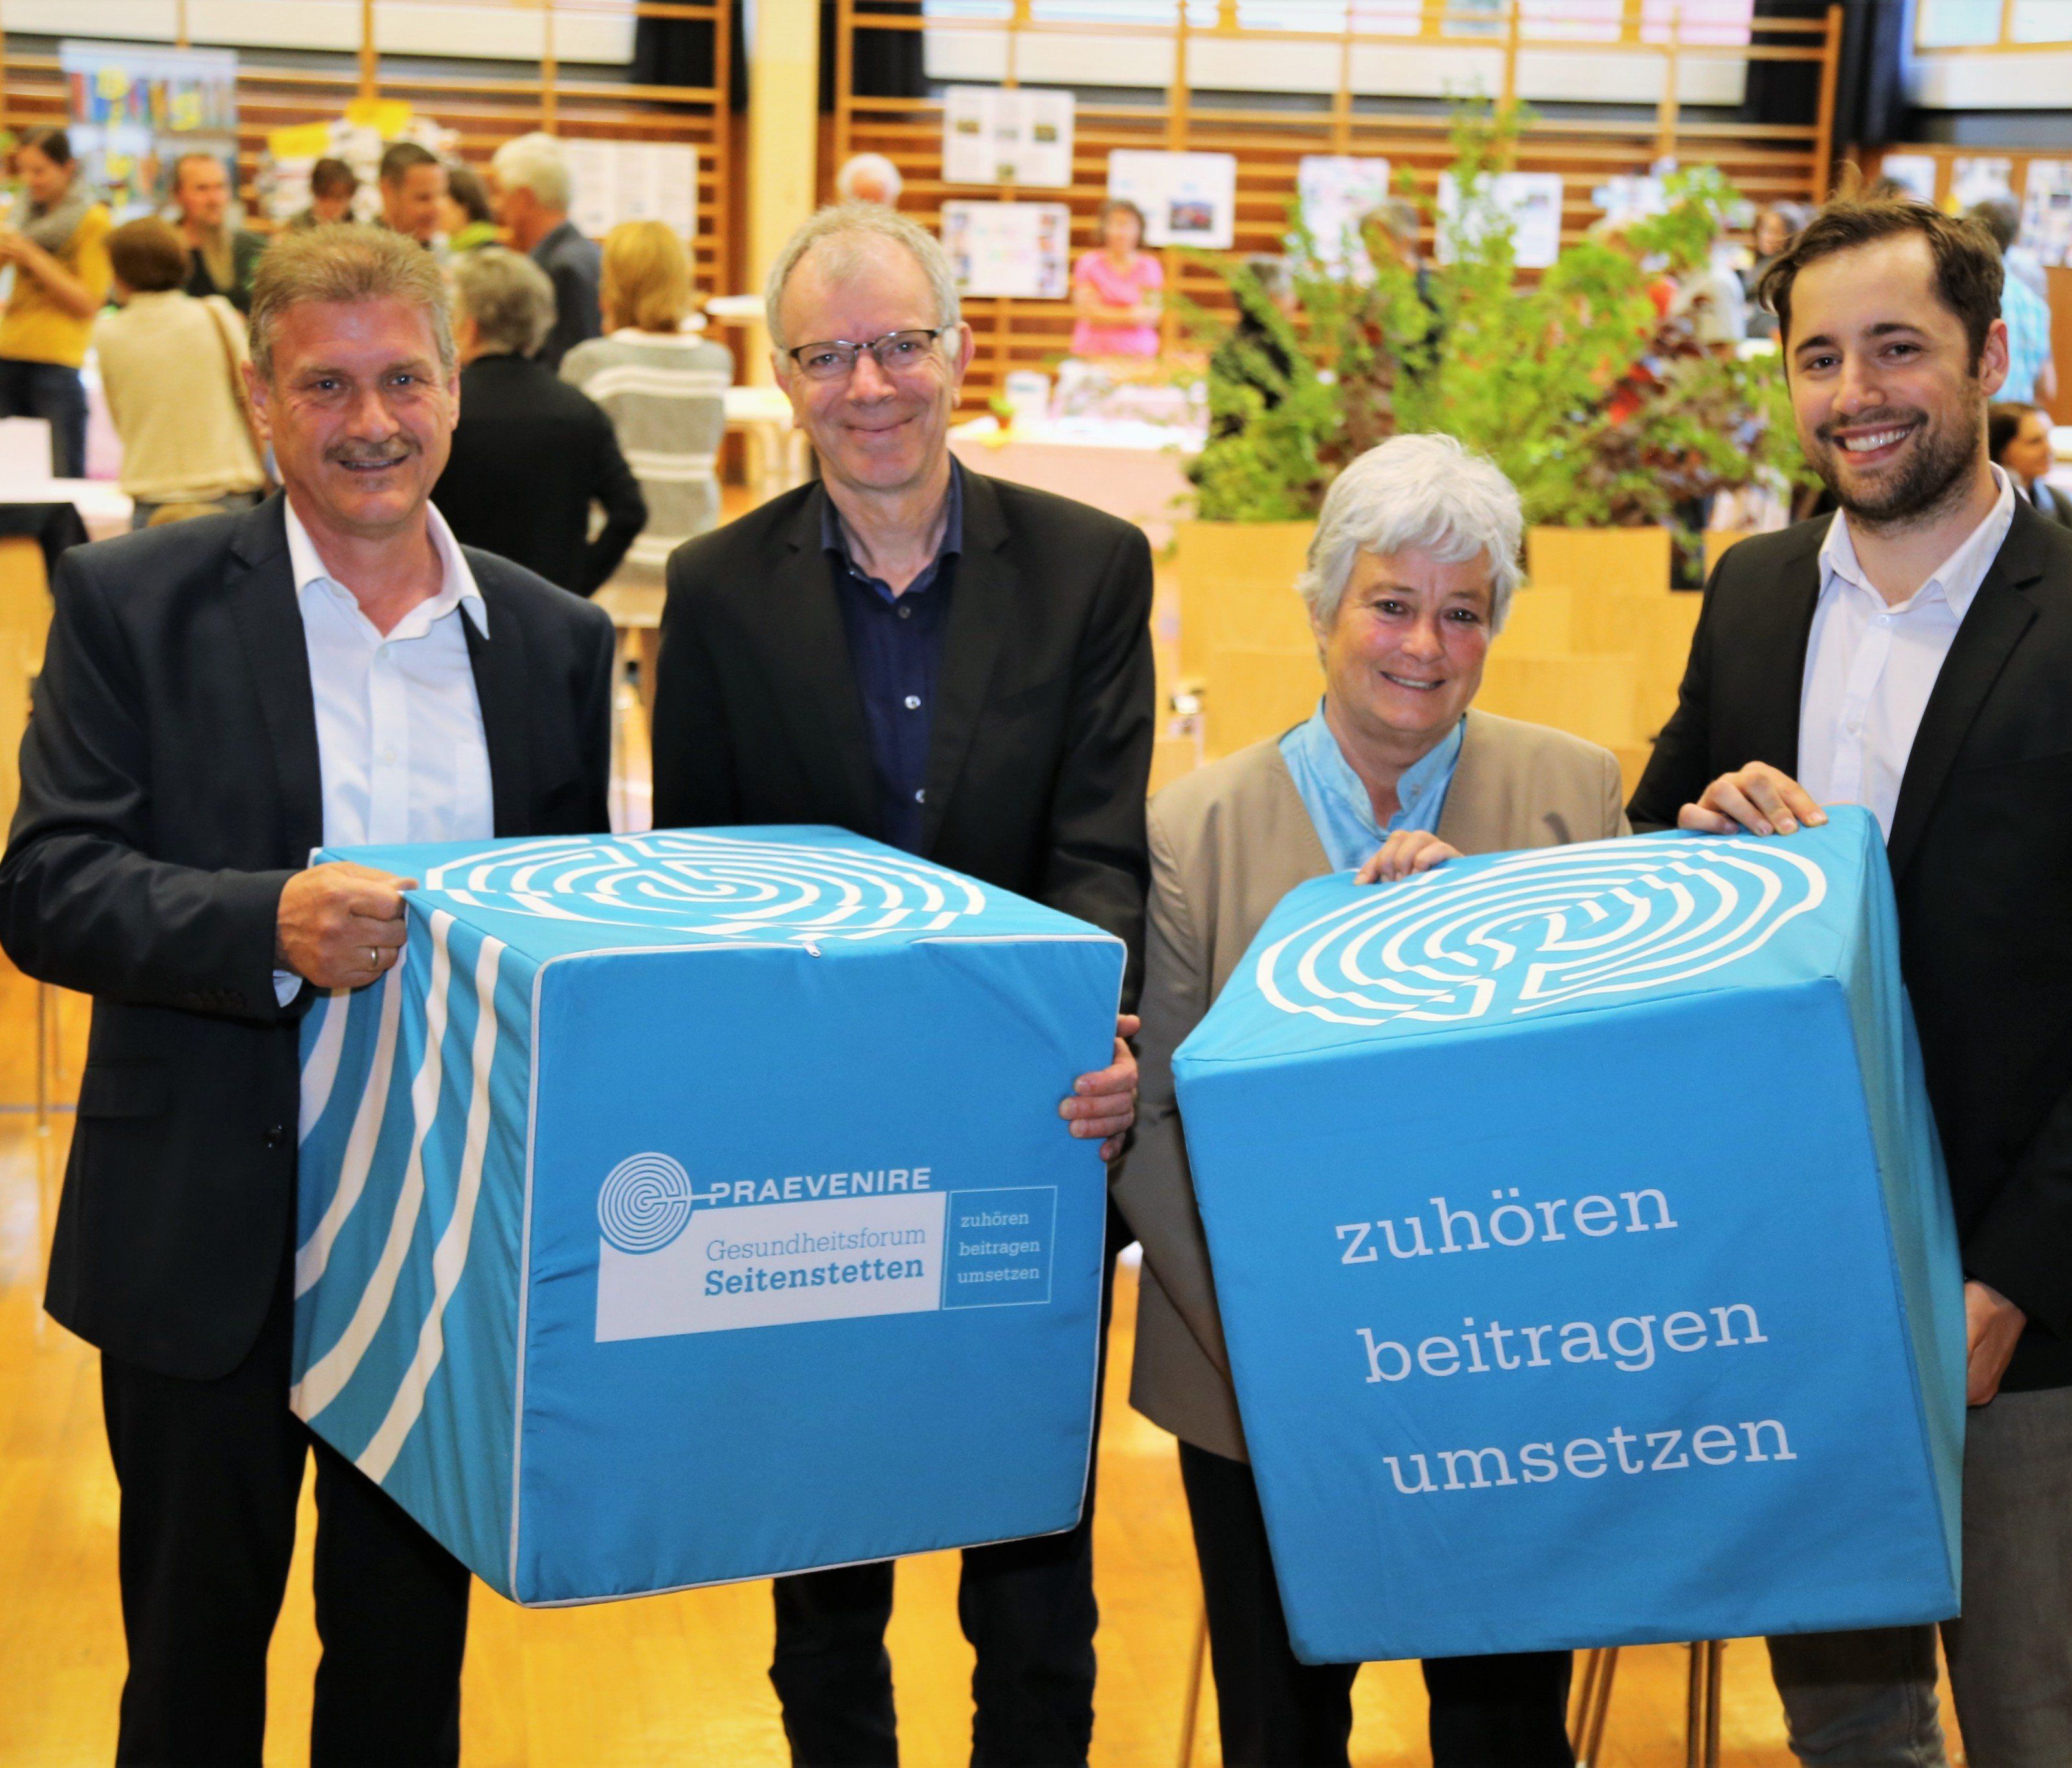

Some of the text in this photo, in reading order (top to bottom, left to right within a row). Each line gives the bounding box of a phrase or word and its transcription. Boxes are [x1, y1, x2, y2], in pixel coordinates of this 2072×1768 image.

[710, 1167, 932, 1205] PRAEVENIRE
[960, 1210, 1030, 1228] zuhören
[1335, 1185, 1678, 1265] zuhören
[706, 1225, 926, 1262] Gesundheitsforum
[958, 1237, 1041, 1257] beitragen
[704, 1254, 925, 1296] Seitenstetten
[957, 1265, 1040, 1284] umsetzen
[1356, 1301, 1768, 1384] beitragen
[1382, 1416, 1797, 1495] umsetzen
